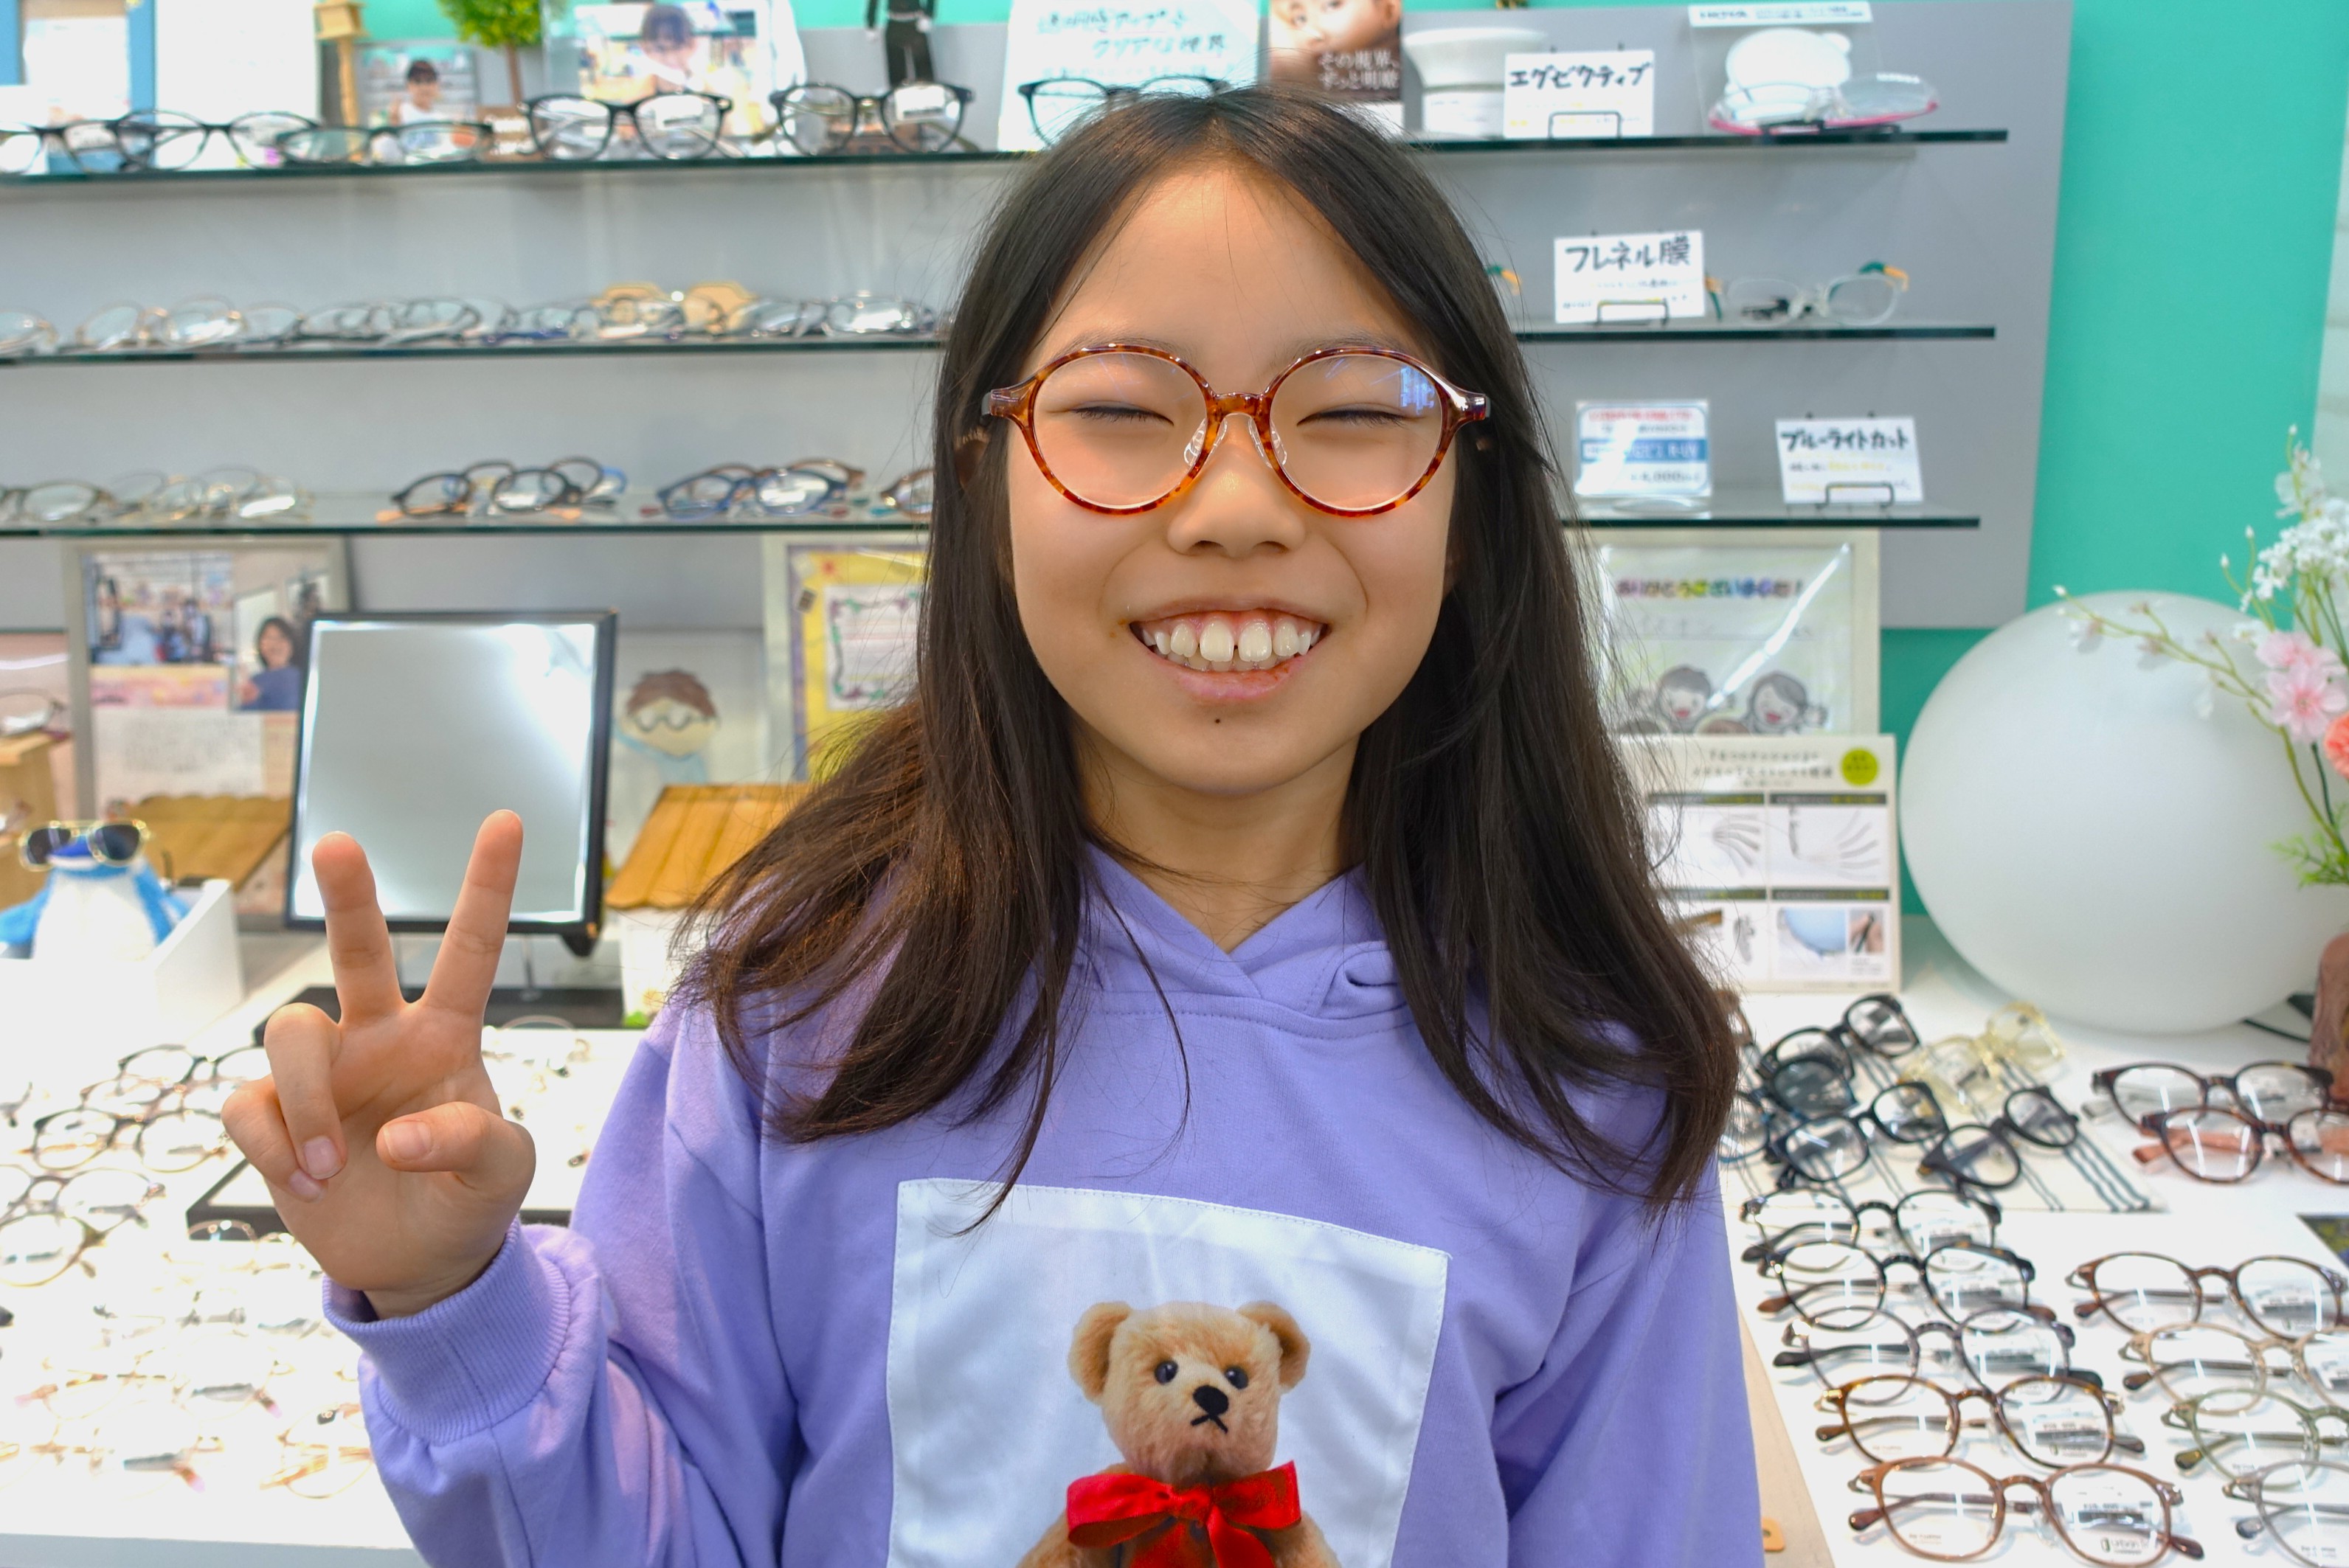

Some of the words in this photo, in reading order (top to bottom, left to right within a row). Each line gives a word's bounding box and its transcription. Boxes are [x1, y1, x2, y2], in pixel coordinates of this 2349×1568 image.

[1565, 235, 1691, 272] フレネル膜
